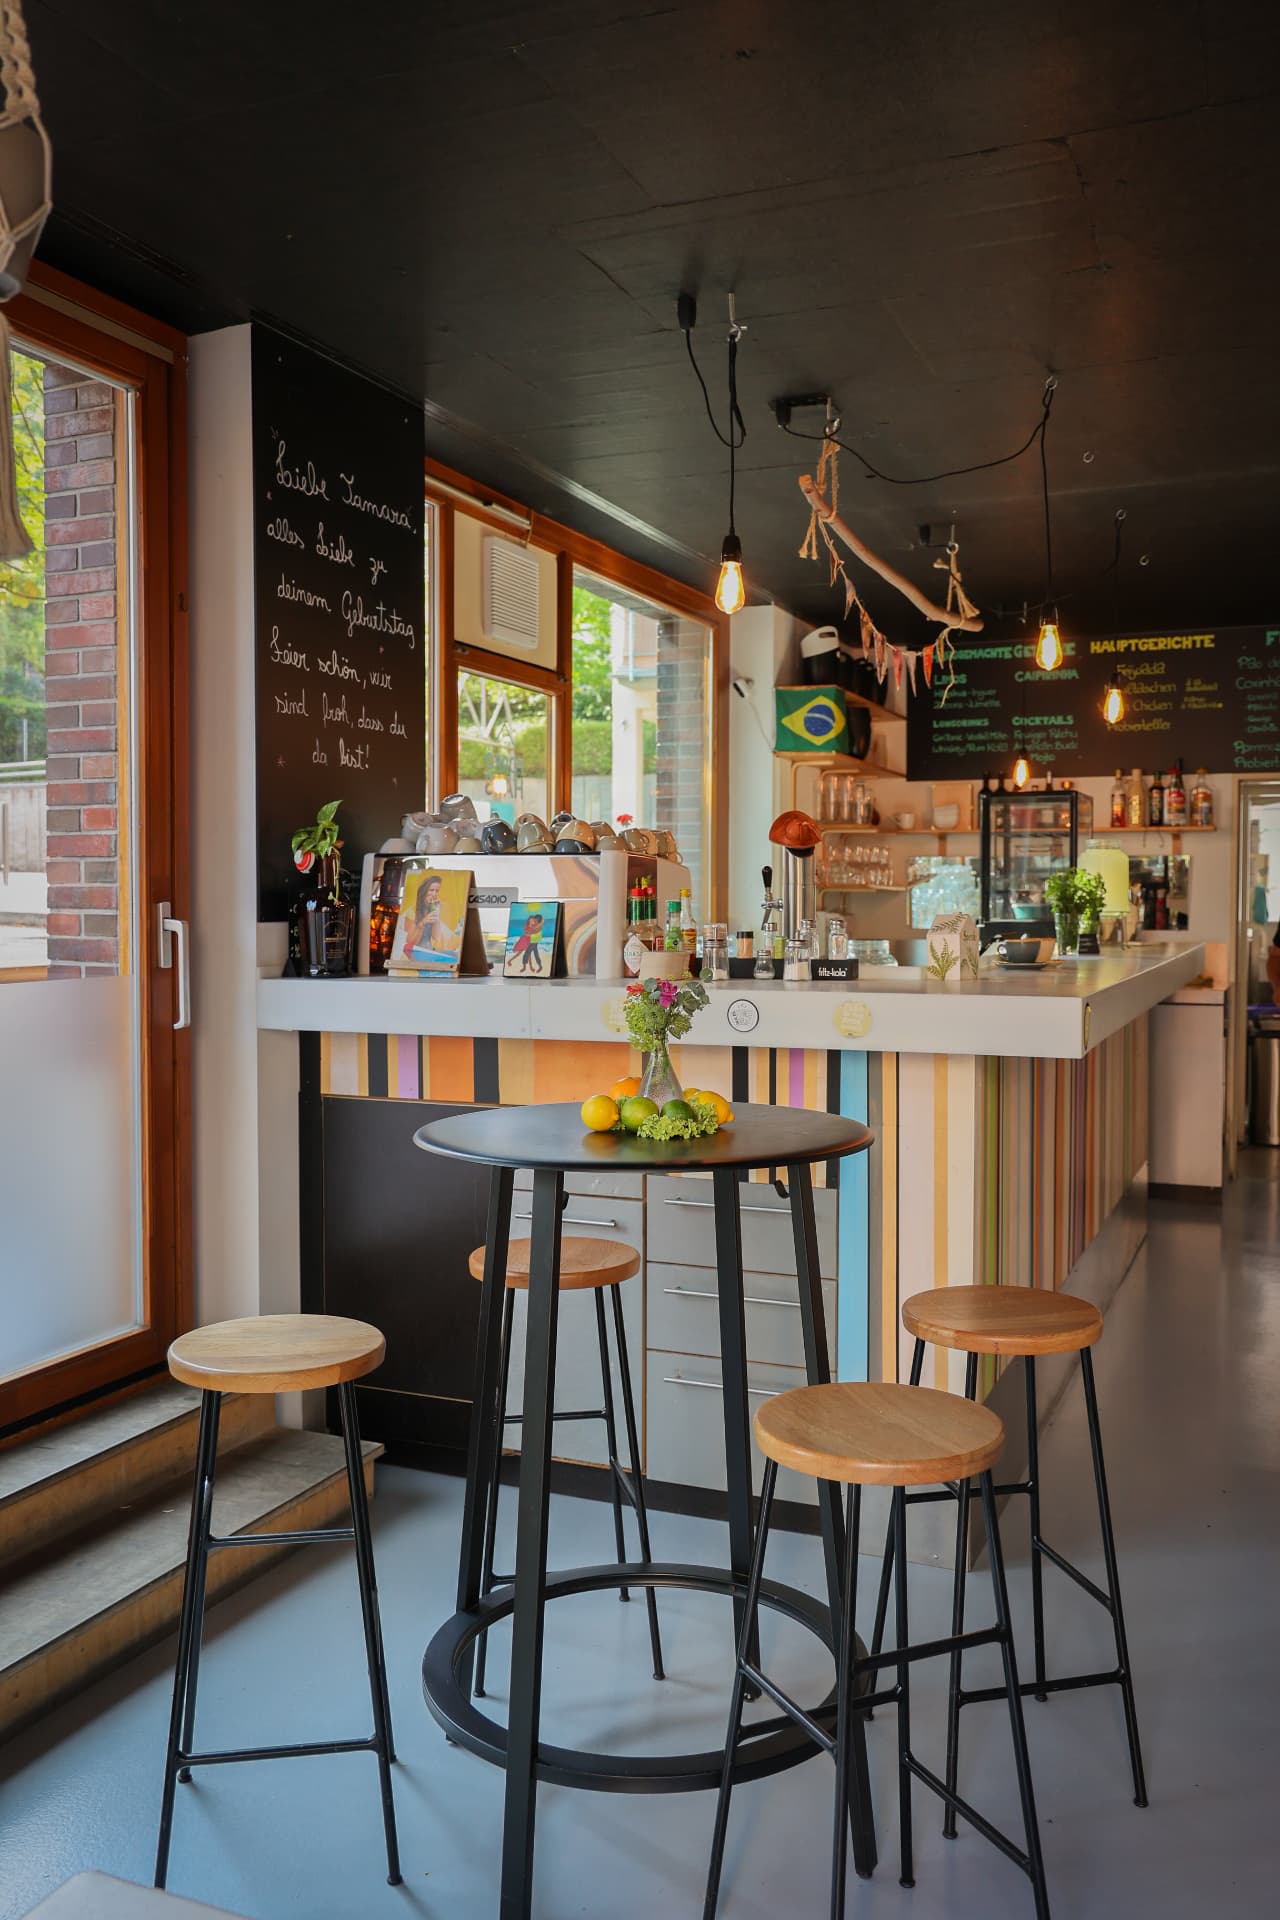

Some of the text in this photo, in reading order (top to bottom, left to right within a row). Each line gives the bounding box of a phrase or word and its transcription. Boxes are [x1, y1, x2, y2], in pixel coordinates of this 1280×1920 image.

[275, 440, 330, 502] Liebe
[266, 517, 389, 587] alles Liebe zu
[277, 572, 415, 649] deinem Geburtstag
[1090, 634, 1215, 654] HAUPTGERICHTE
[274, 688, 309, 717] sind
[357, 706, 385, 732] dass
[389, 711, 409, 739] du
[1011, 714, 1074, 727] COCKTAILS
[312, 738, 328, 766] da
